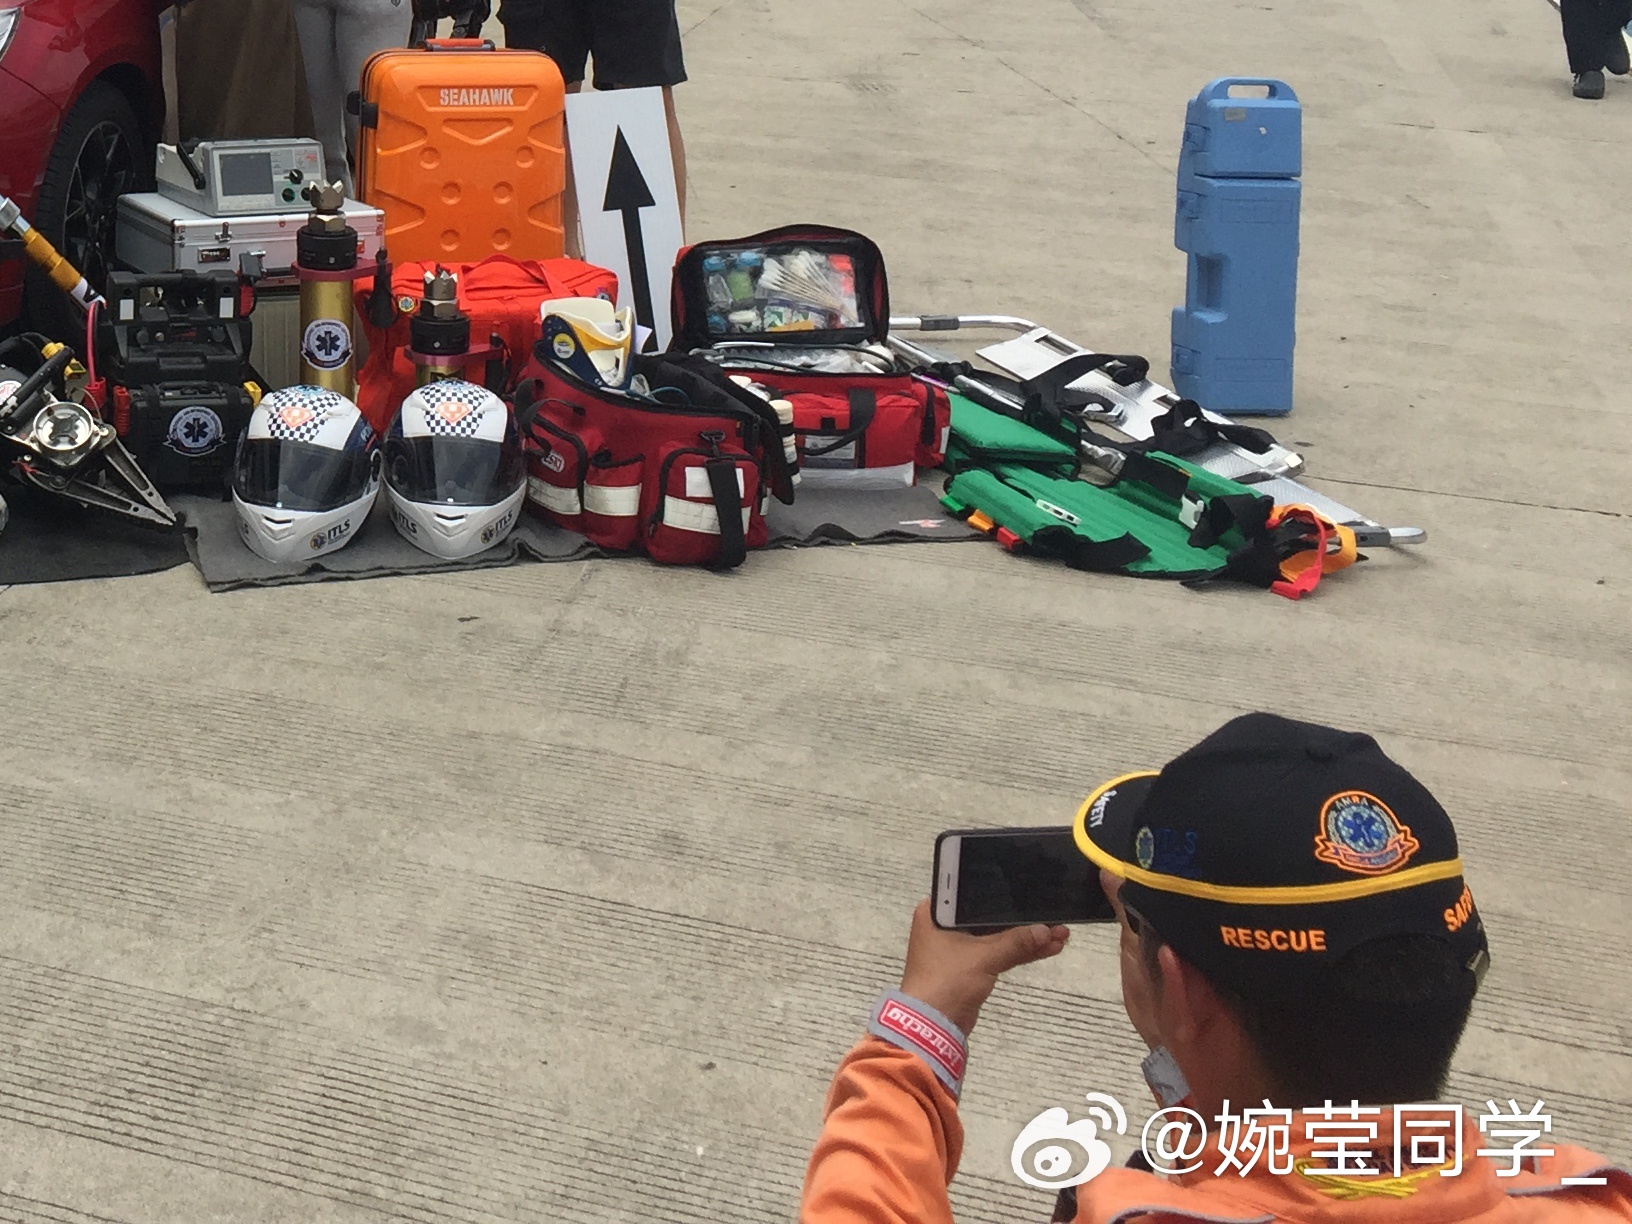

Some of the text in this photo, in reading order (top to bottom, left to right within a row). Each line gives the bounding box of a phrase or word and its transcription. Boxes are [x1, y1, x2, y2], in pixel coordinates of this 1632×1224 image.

[439, 88, 515, 107] SEAHAWK
[327, 518, 351, 540] ITLS
[495, 509, 514, 531] ITLS
[1220, 925, 1327, 952] RESCUE
